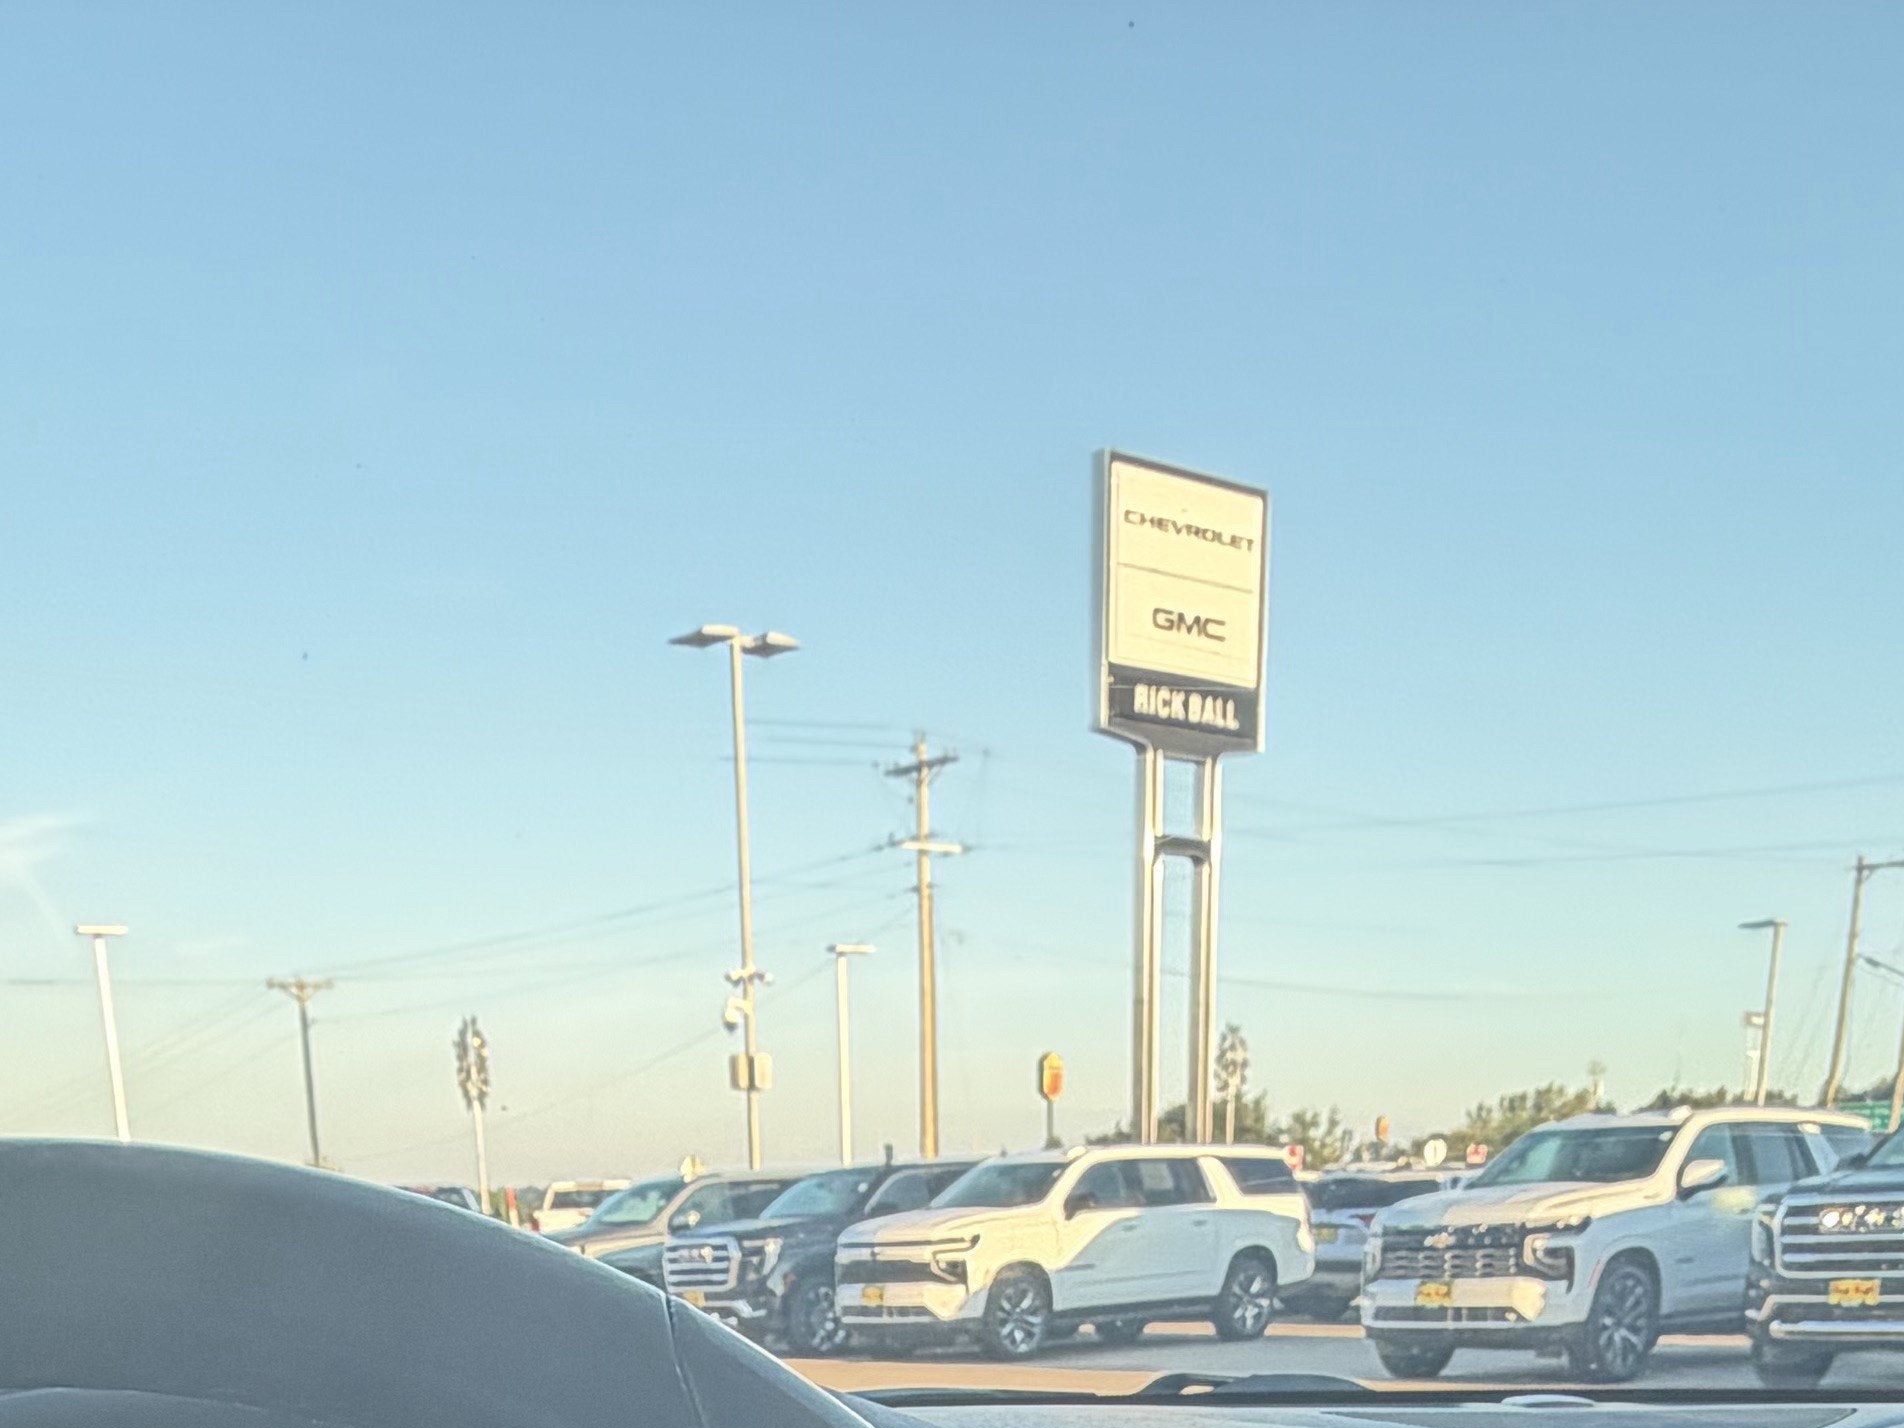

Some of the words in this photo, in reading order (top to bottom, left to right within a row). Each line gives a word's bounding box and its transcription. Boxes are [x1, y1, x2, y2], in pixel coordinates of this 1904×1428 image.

[1123, 509, 1254, 553] CHEVROLET
[1152, 607, 1226, 643] GMC
[1133, 682, 1186, 721] RICK
[1188, 693, 1239, 731] BALL
